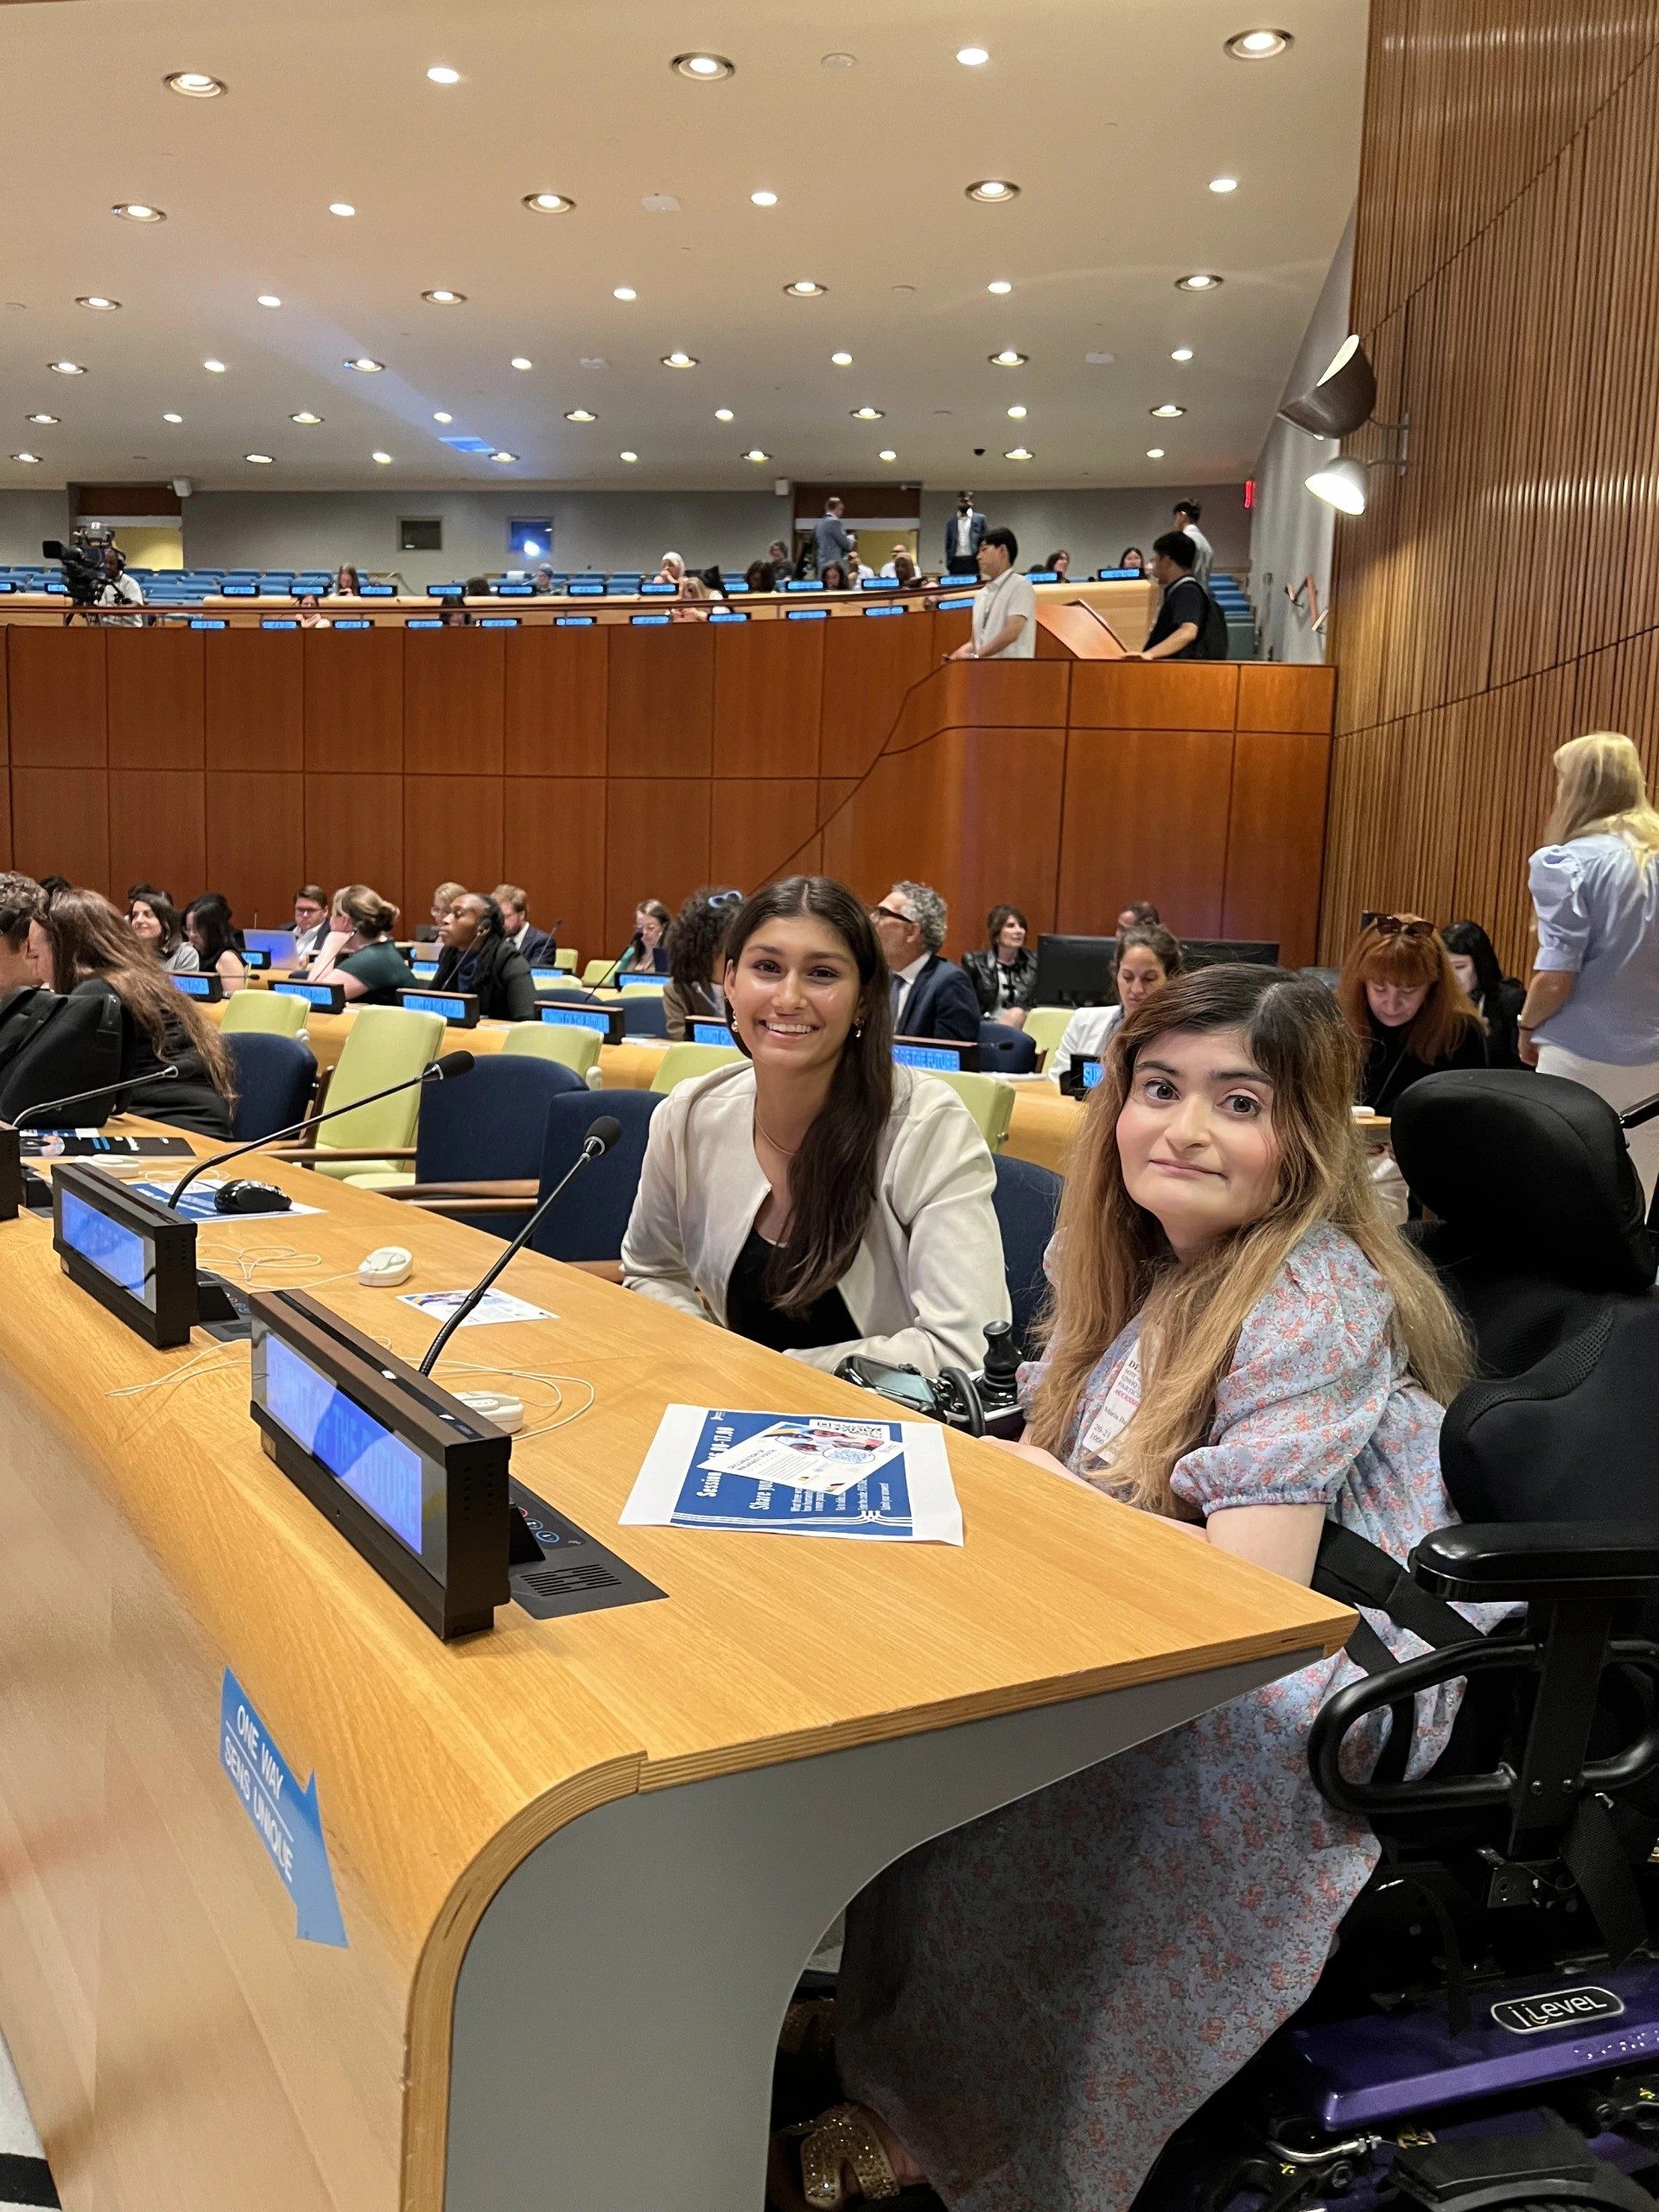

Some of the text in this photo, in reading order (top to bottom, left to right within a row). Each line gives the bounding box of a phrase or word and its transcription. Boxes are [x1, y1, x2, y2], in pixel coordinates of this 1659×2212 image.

[696, 1471, 721, 1497] Session
[748, 1491, 771, 1510] Share
[237, 1705, 284, 1801] ONE WAY
[225, 1735, 294, 1884] SENS UNIQUE
